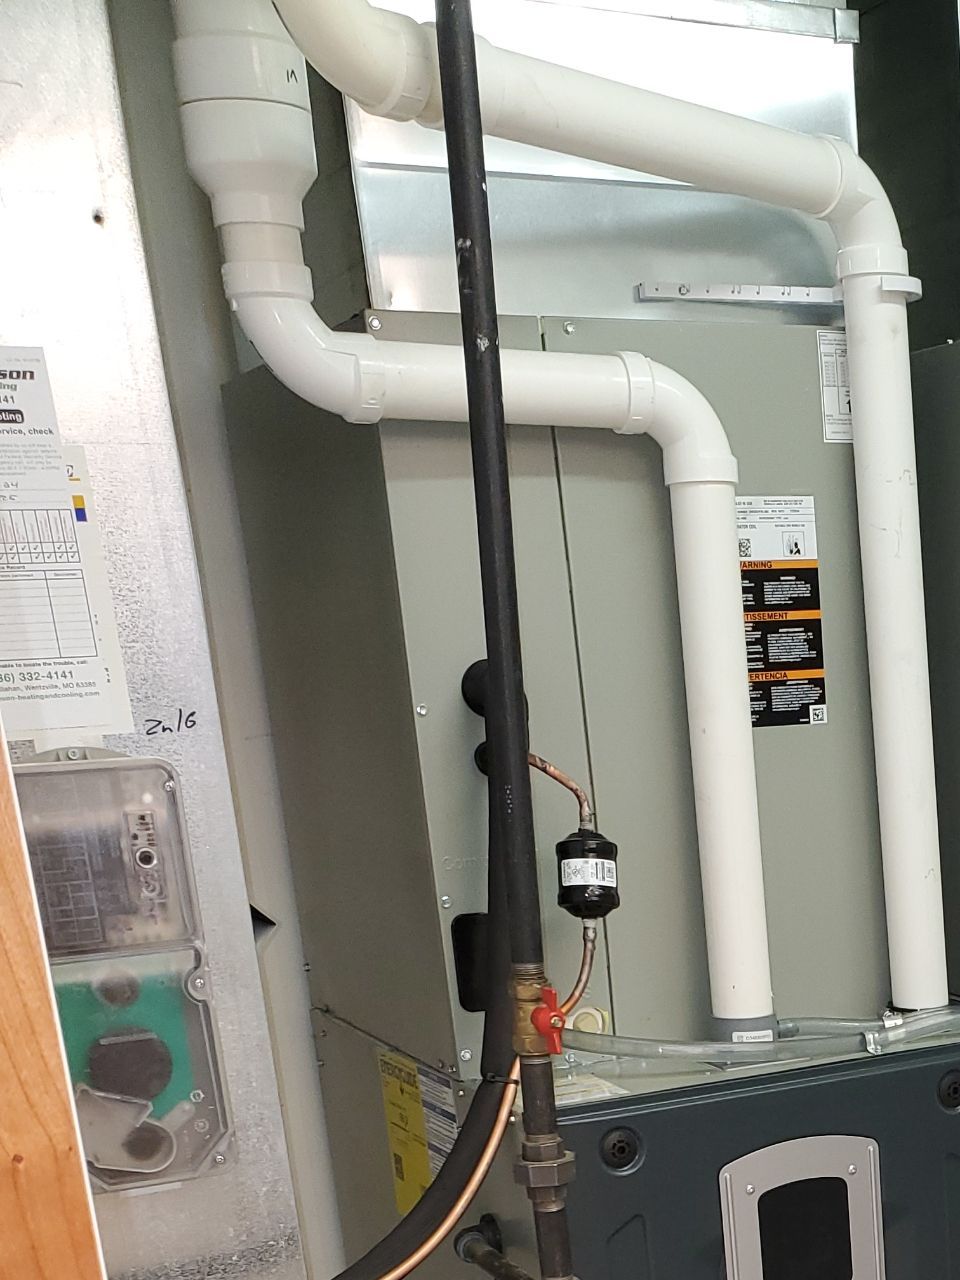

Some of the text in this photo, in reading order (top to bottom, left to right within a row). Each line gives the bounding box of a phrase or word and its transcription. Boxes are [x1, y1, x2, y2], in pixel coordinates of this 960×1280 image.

[0, 394, 15, 404] 41
[0, 427, 55, 436] rvice, check
[19, 670, 74, 682] 332-4141
